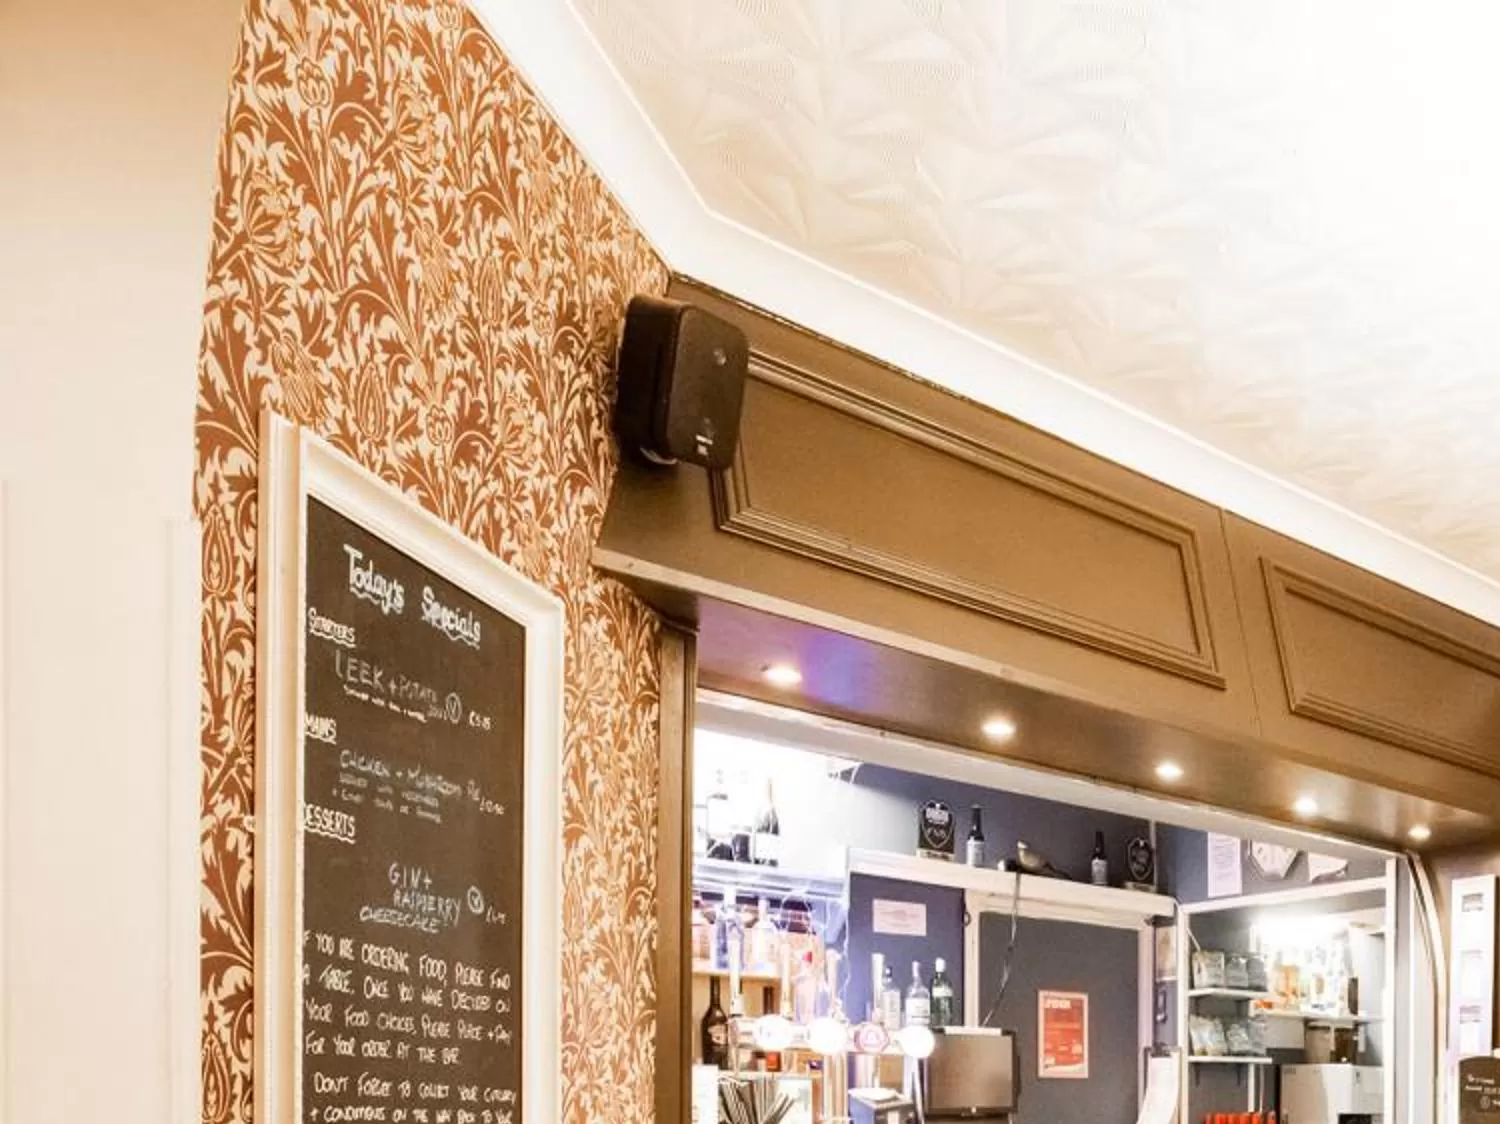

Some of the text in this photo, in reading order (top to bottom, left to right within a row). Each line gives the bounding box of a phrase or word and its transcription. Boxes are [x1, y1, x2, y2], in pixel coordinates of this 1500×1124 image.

[343, 543, 482, 643] Today's Specials
[335, 649, 385, 693] LEEK
